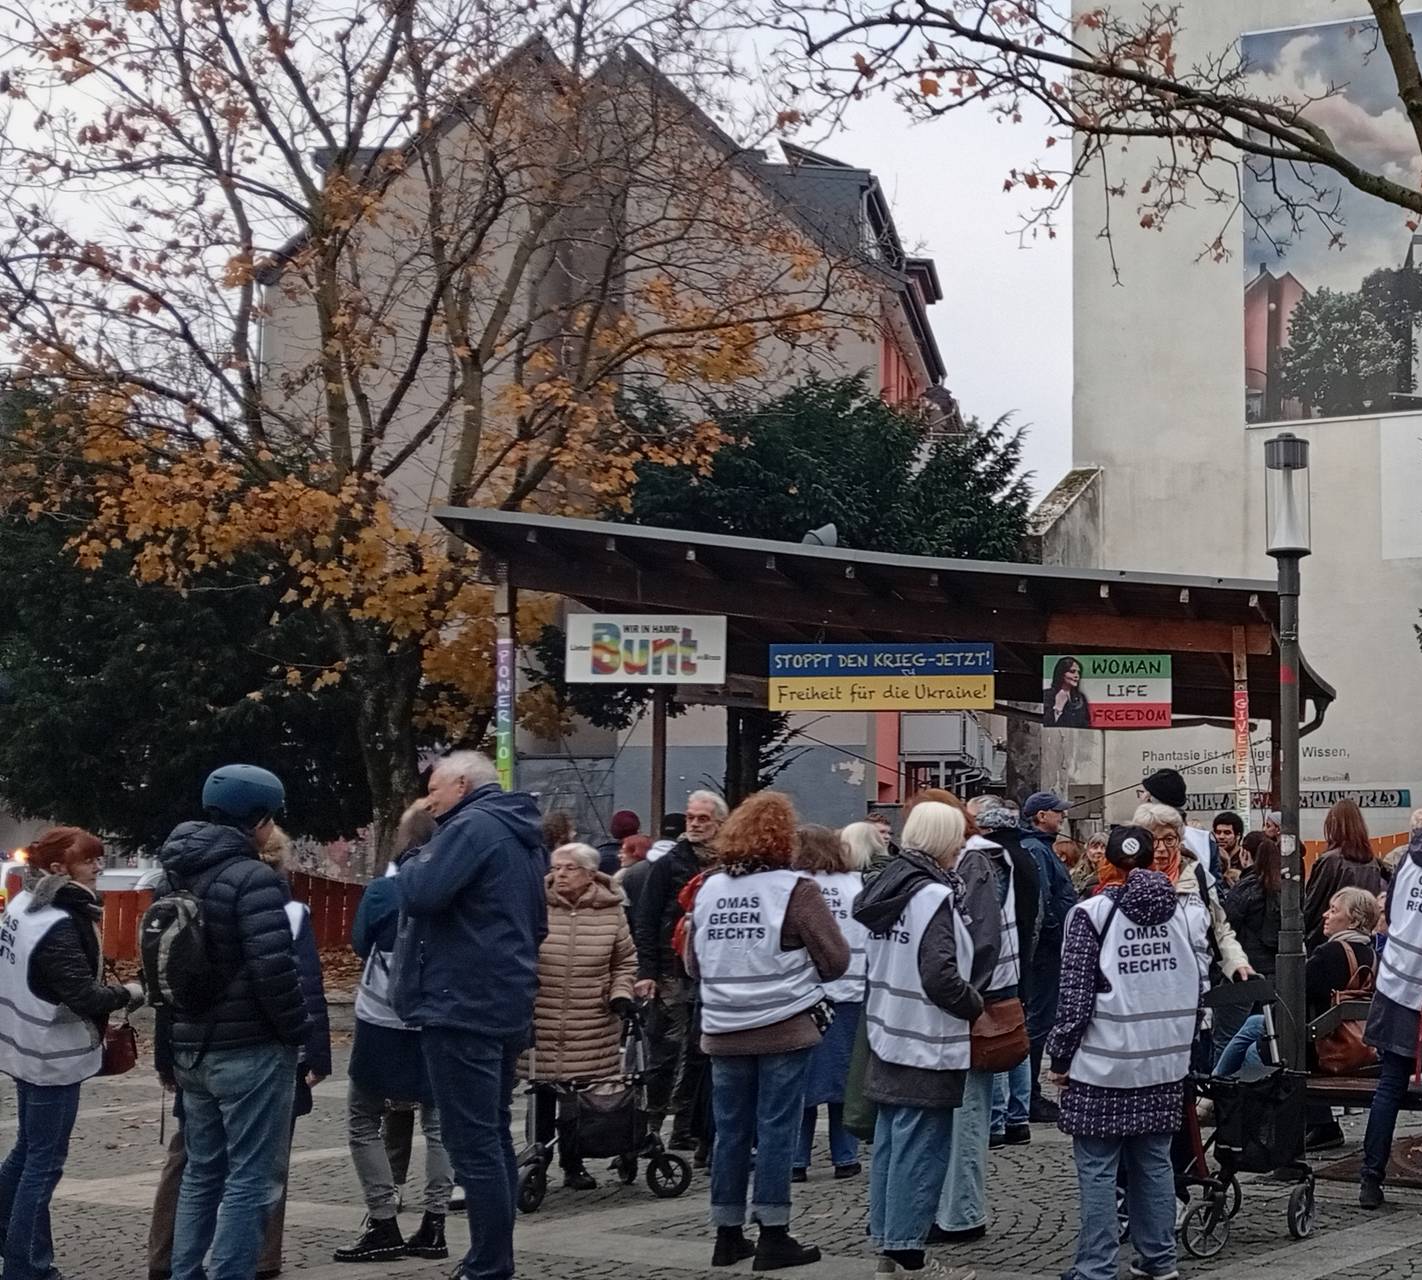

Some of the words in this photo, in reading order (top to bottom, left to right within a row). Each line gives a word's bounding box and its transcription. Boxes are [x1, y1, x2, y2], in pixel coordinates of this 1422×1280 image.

[591, 622, 698, 675] Bunt
[774, 653, 833, 669] STOPPT
[838, 654, 868, 667] DEN
[1092, 659, 1161, 674] WOMAN
[497, 649, 511, 723] POWER
[777, 685, 842, 703] Freiheit
[850, 683, 875, 702] für
[882, 686, 909, 699] die
[915, 684, 987, 700] Ukraine!
[1107, 684, 1148, 697] LIFE
[1092, 709, 1167, 722] FREEDOM
[1235, 699, 1248, 744] GIVE
[497, 732, 511, 759] TO
[1142, 750, 1200, 761] Phantasie
[1204, 749, 1219, 760] ist
[717, 896, 760, 909] OMAS
[709, 911, 761, 925] GEGEN
[708, 927, 766, 941] RECHTS
[1124, 925, 1169, 941] OMAS
[1118, 942, 1171, 958] GEGEN
[1118, 958, 1178, 975] RECHTS
